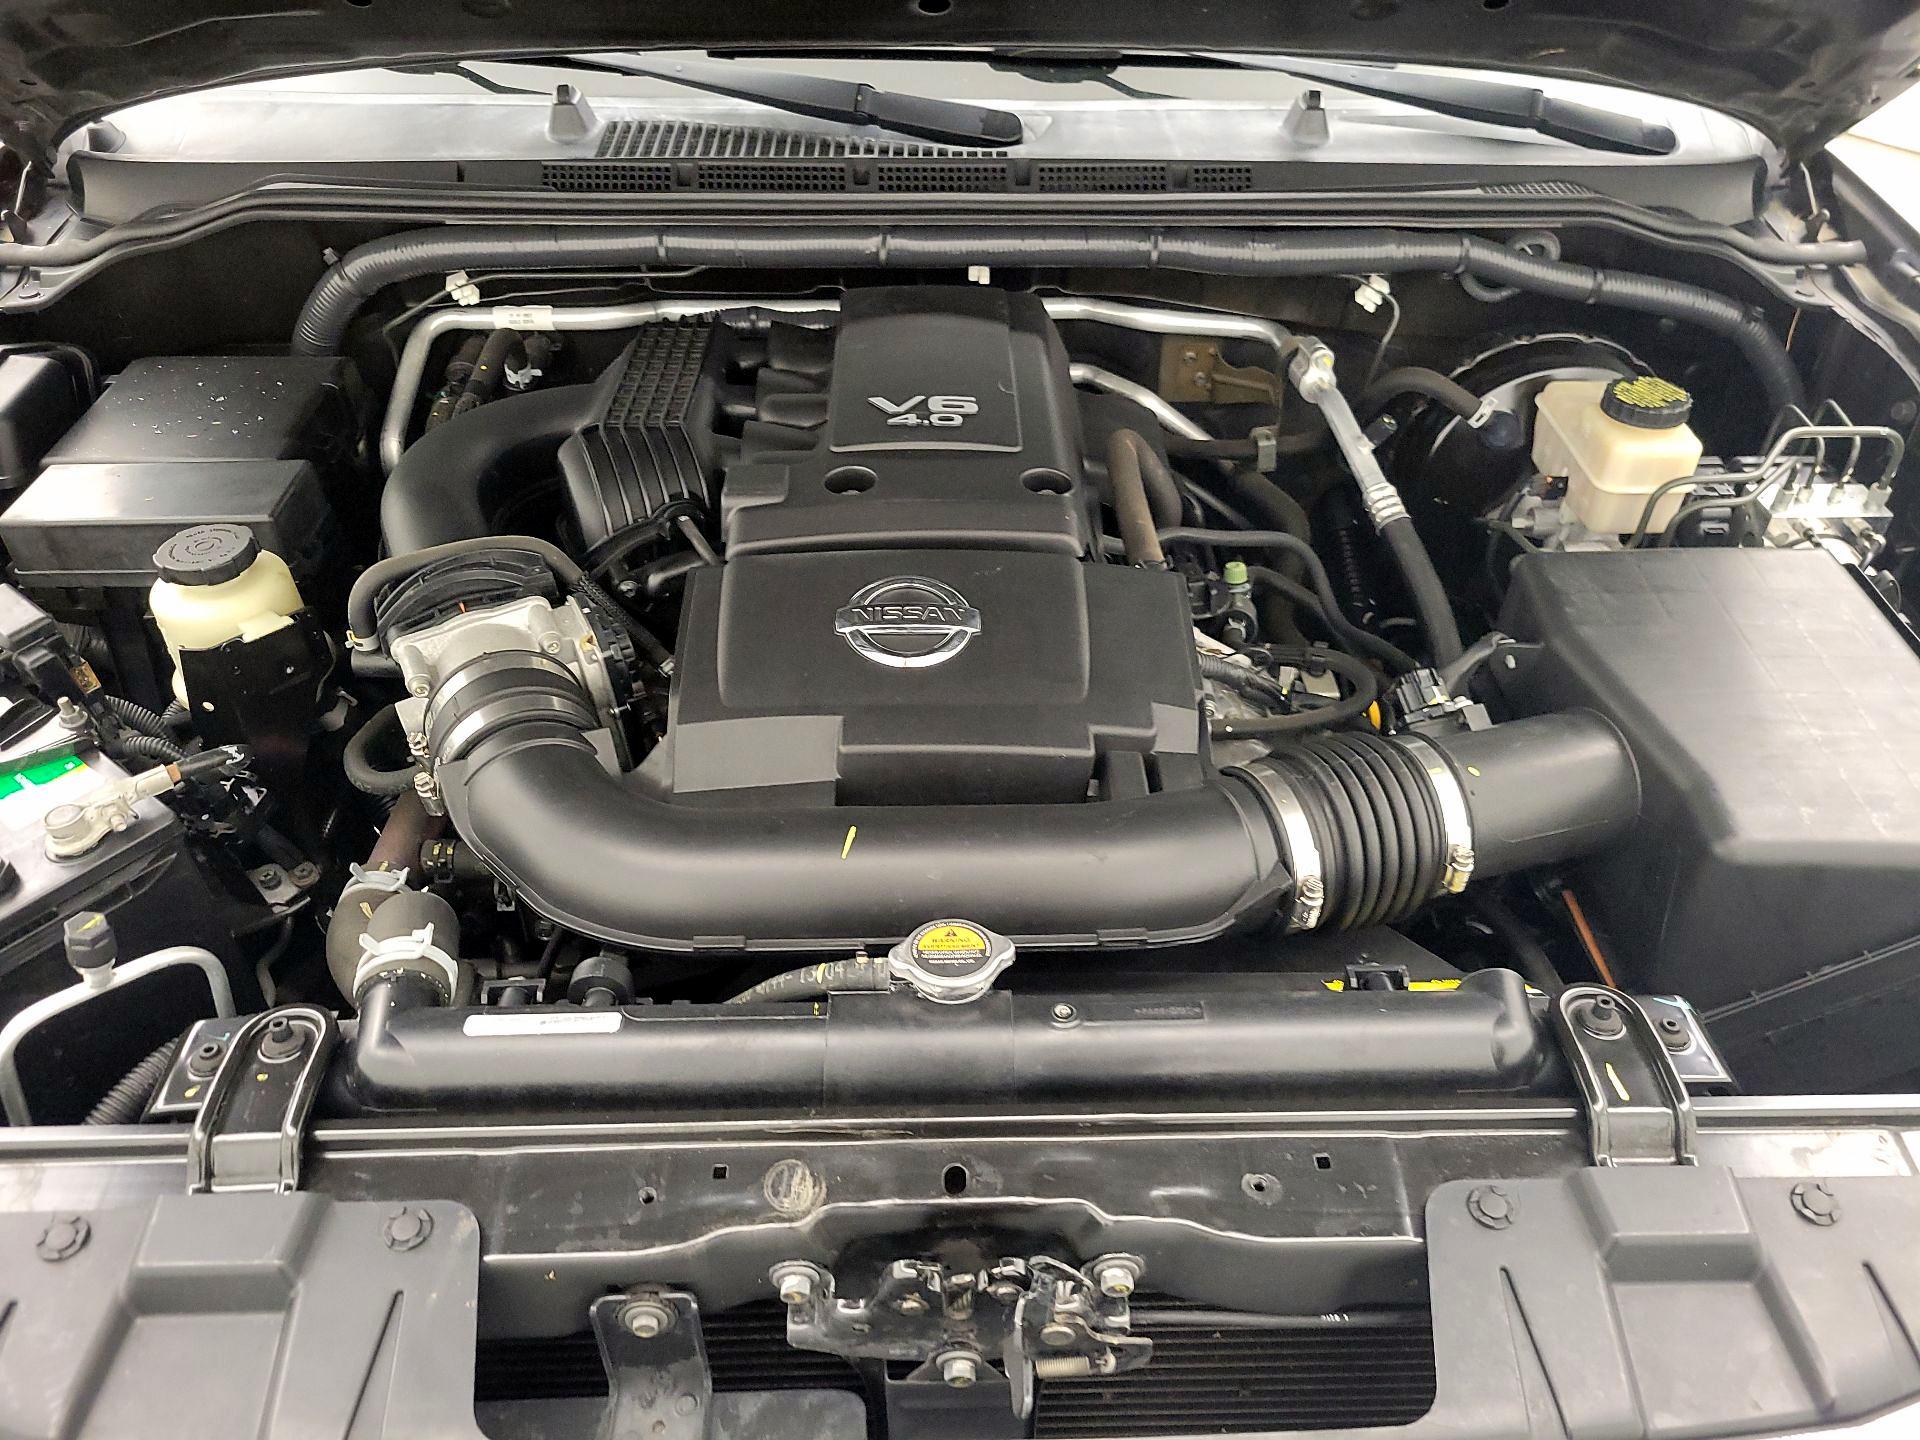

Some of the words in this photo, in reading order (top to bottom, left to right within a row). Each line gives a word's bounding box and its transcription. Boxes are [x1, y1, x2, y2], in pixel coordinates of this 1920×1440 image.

[867, 395, 979, 415] V6
[887, 413, 963, 426] 4.0
[851, 606, 966, 622] NISSAN
